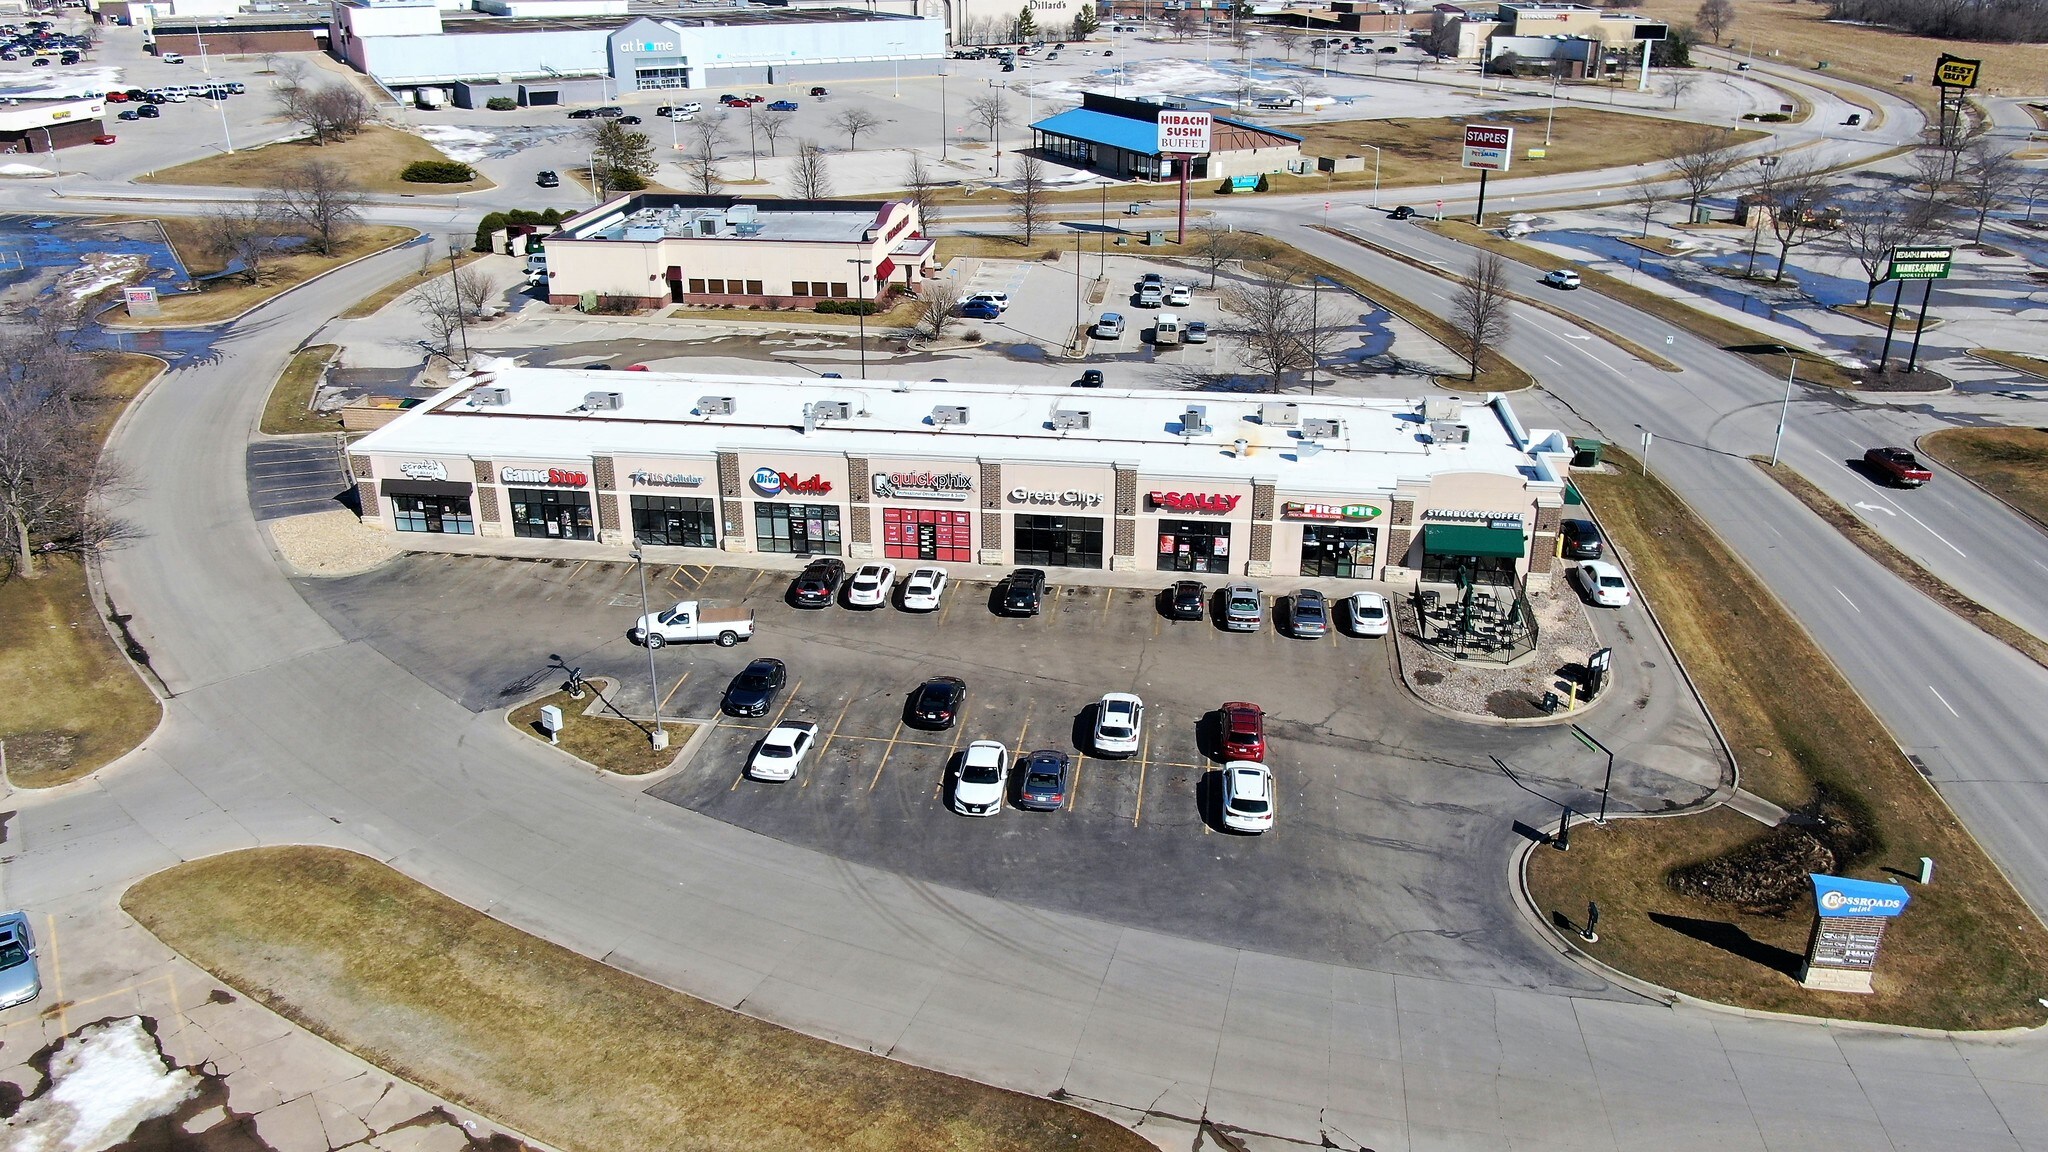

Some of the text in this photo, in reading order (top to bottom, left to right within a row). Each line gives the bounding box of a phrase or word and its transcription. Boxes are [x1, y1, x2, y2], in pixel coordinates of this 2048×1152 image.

[1029, 0, 1067, 10] Dillard's
[620, 38, 674, 52] at home
[1944, 65, 1974, 74] BEST
[1943, 72, 1969, 81] BUY
[1161, 115, 1208, 126] HIBACHI
[1166, 127, 1202, 137] SUSHI
[1467, 131, 1507, 144] STAPLES
[1161, 138, 1207, 148] BUFFET
[402, 461, 438, 471] scratch
[502, 467, 588, 486] GameStop
[757, 472, 832, 490] Diva Nails
[891, 471, 972, 489] quickphix
[1011, 486, 1105, 506] Great Clips
[1165, 492, 1241, 510] SALLY
[1303, 504, 1342, 515] Pita
[1346, 506, 1375, 516] Pit
[1427, 509, 1489, 519] STARBUCKS
[1821, 891, 1900, 909] CROSSROADS
